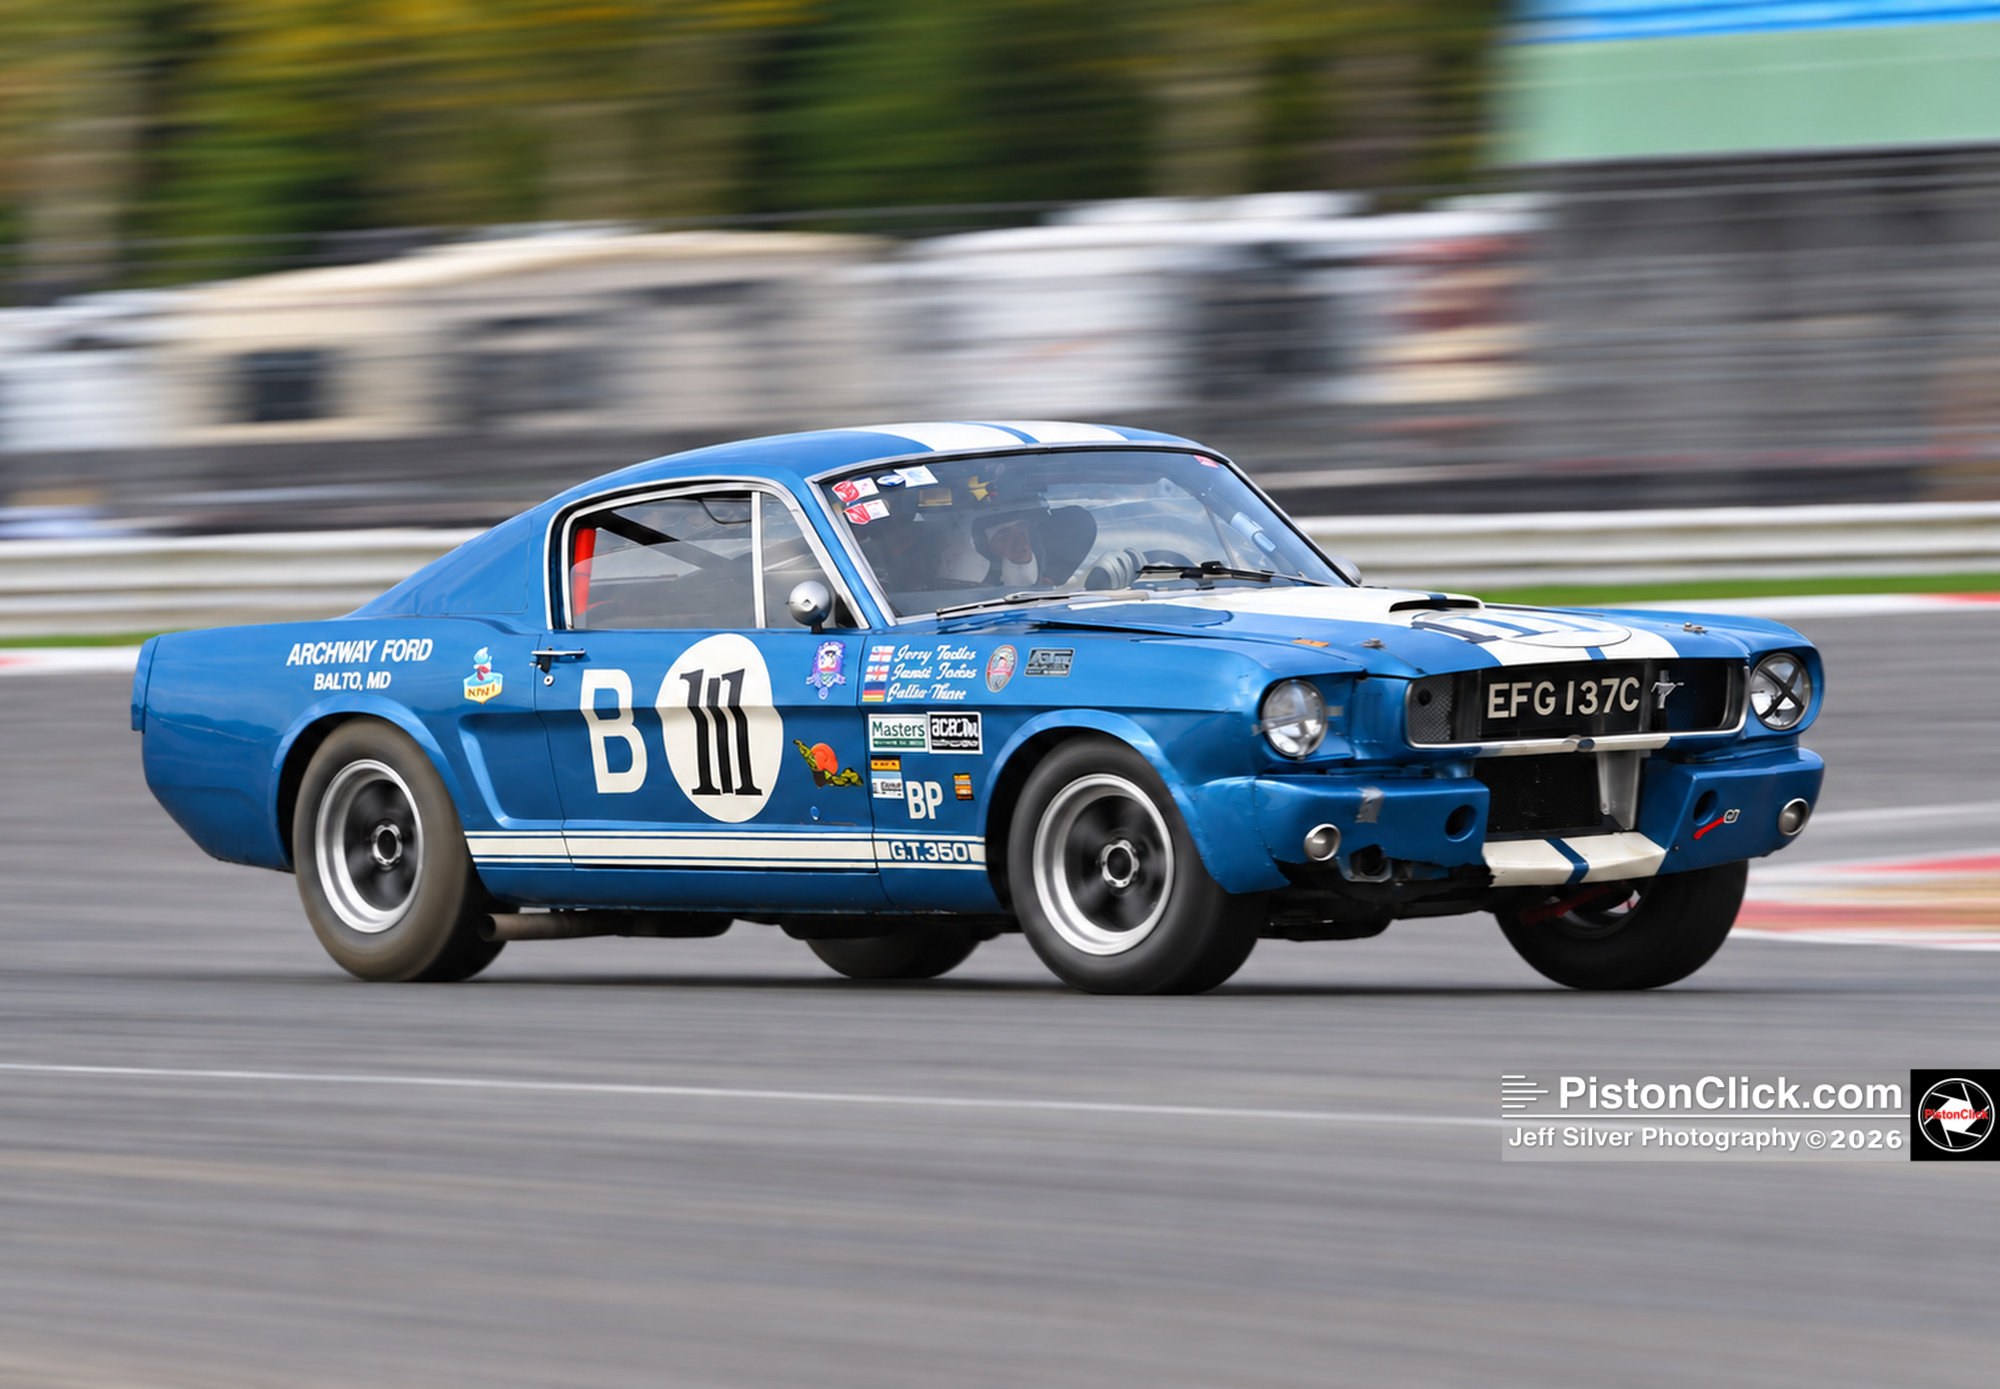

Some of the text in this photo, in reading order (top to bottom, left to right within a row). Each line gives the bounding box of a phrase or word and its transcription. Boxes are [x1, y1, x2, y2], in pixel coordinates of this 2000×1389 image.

[286, 638, 433, 666] ARCHWAY FORD
[313, 671, 392, 691] BALTO, MD
[1487, 676, 1641, 719] EFG 137C
[580, 669, 648, 794] B
[679, 668, 763, 796] 111
[872, 720, 926, 738] Masters
[905, 781, 943, 819] BP
[890, 841, 969, 862] G.T.350
